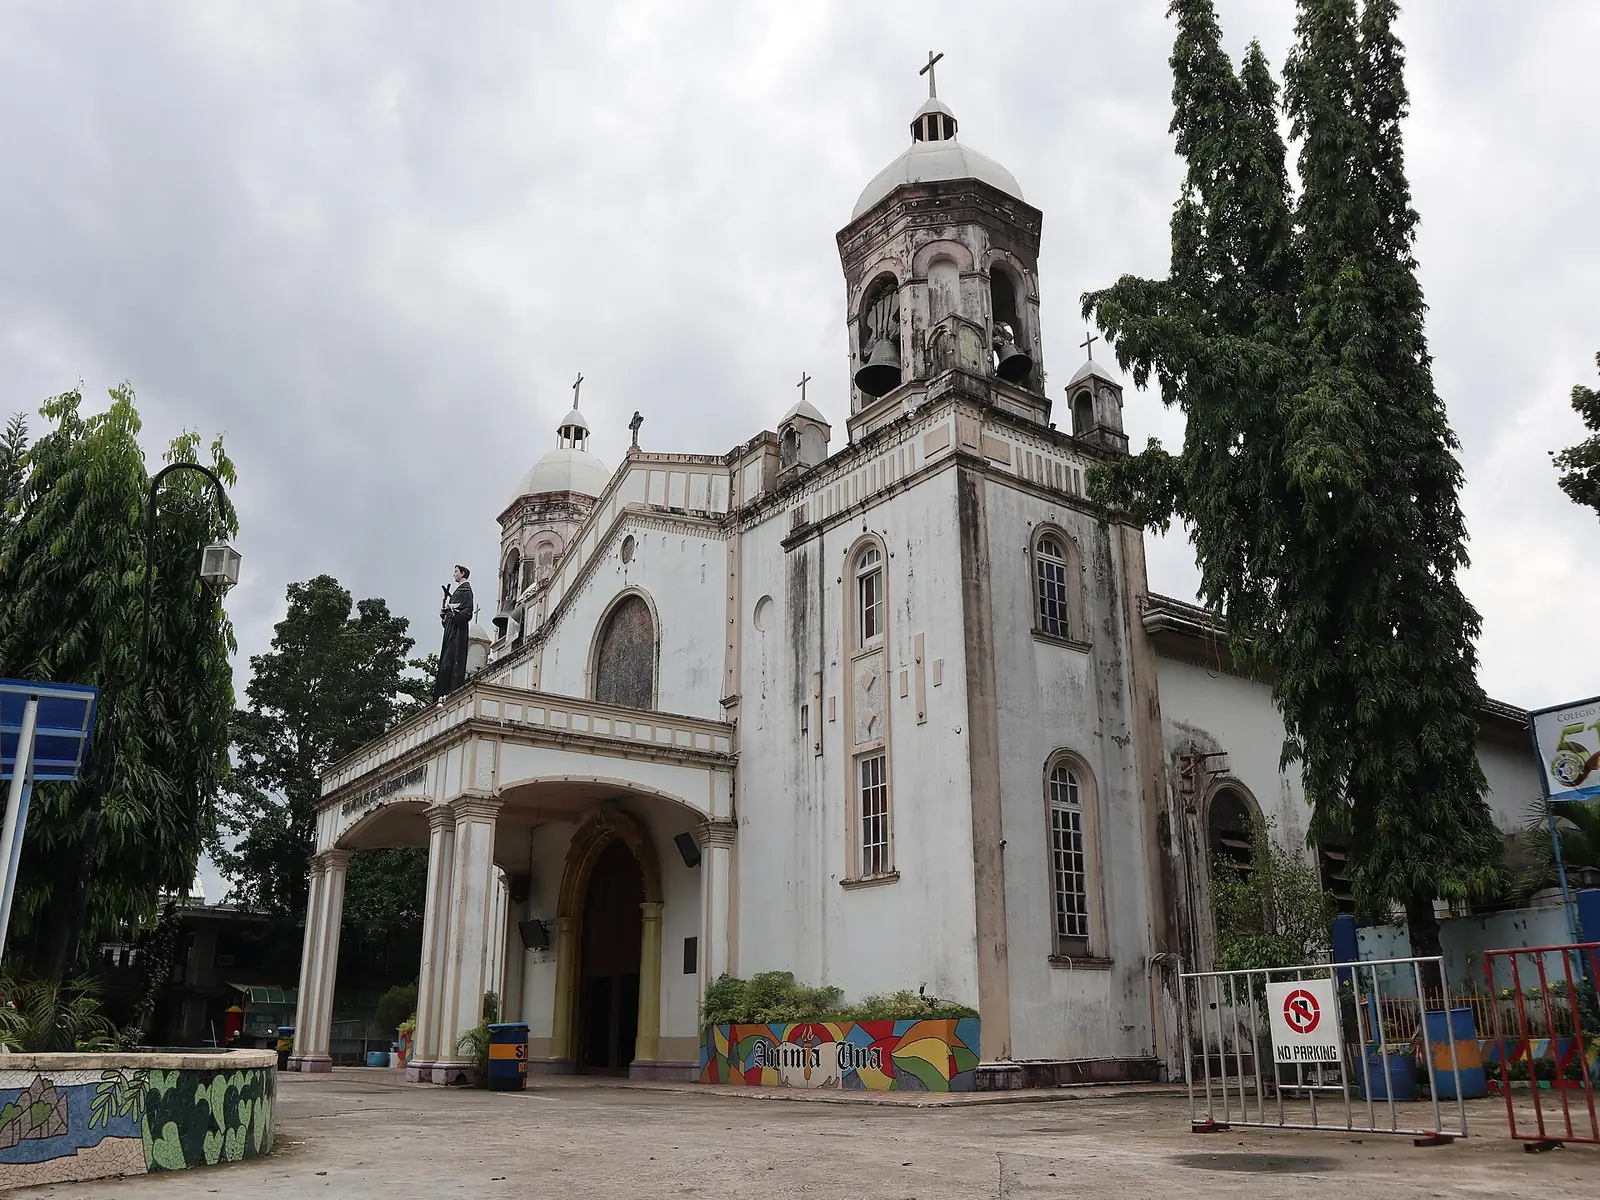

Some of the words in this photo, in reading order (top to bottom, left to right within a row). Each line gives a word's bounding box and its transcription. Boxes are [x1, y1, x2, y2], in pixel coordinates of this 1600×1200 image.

[1556, 708, 1596, 723] COLEGIO
[753, 1040, 821, 1069] Anima
[836, 1041, 884, 1071] Una
[1277, 1045, 1291, 1060] NO
[1293, 1045, 1337, 1060] PARKING
